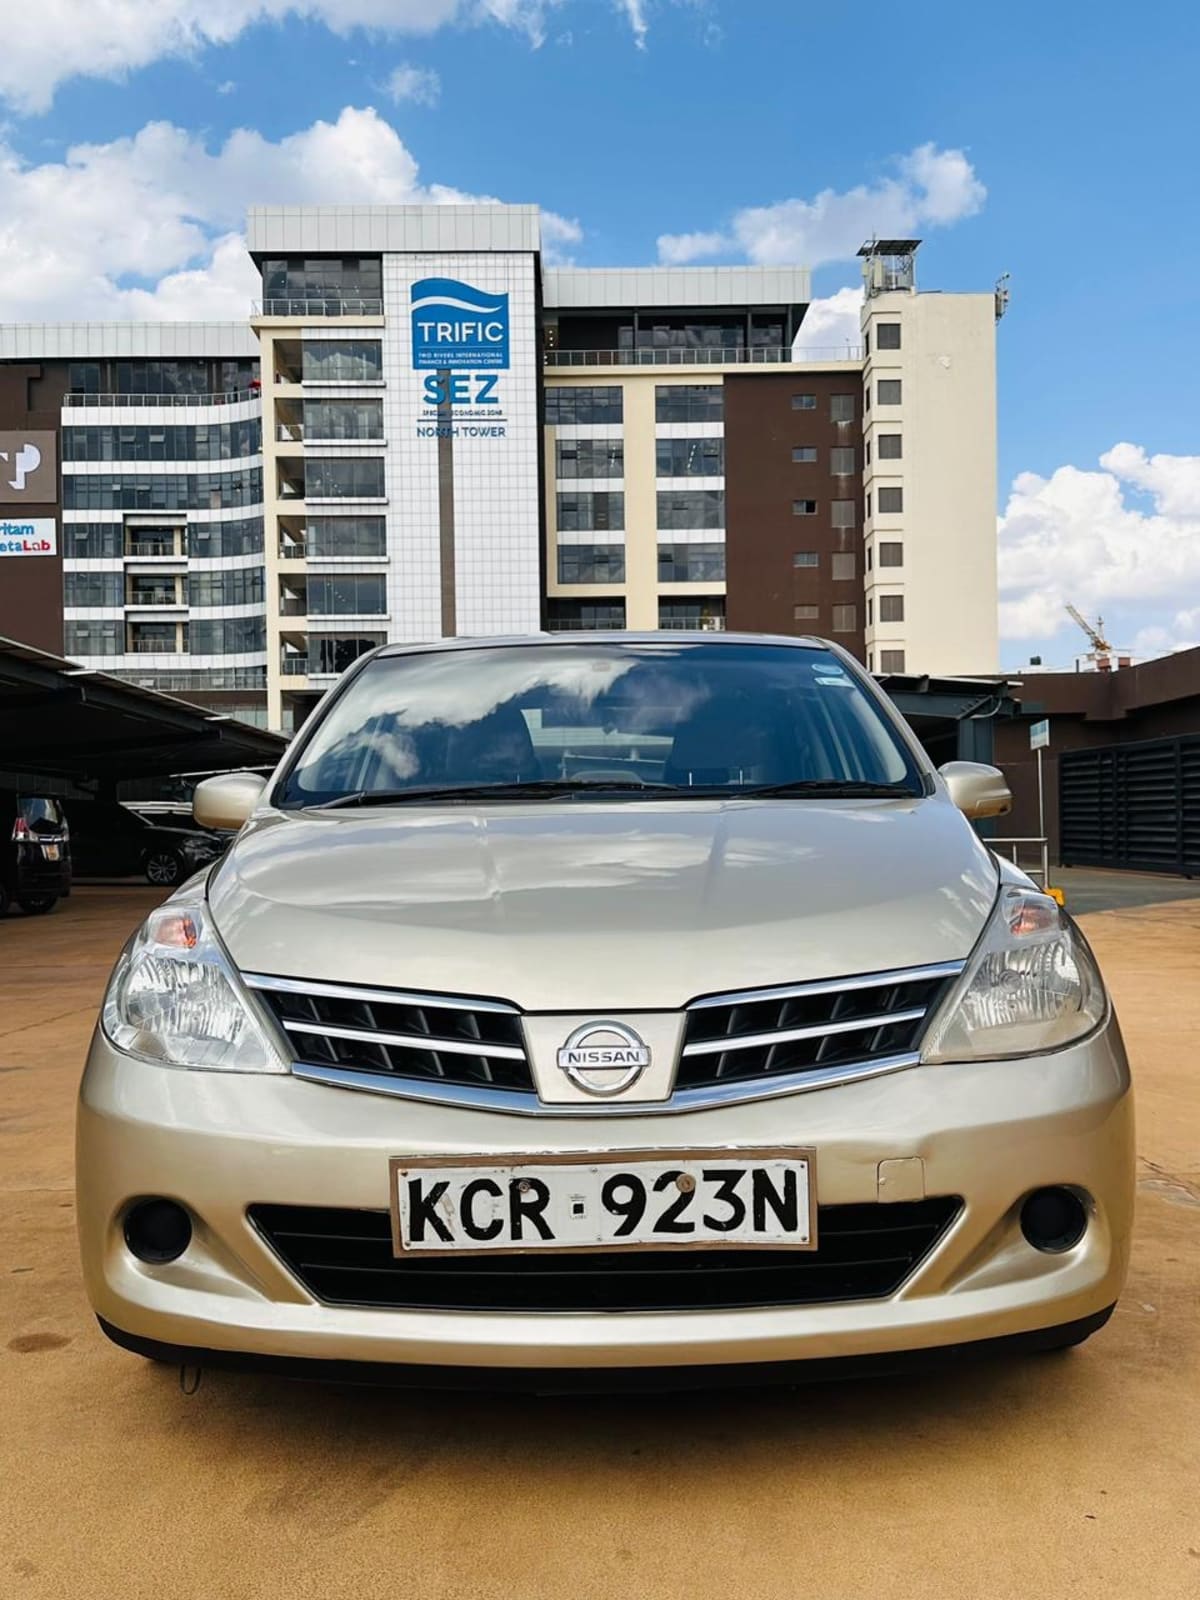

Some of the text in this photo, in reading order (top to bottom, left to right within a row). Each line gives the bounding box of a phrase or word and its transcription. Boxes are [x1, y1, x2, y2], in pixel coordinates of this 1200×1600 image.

[417, 322, 504, 342] TRIFIC
[423, 374, 499, 405] SEZ
[461, 427, 506, 438] TOWER
[568, 1051, 640, 1064] NISSAN
[407, 1169, 799, 1243] KCR 923N
